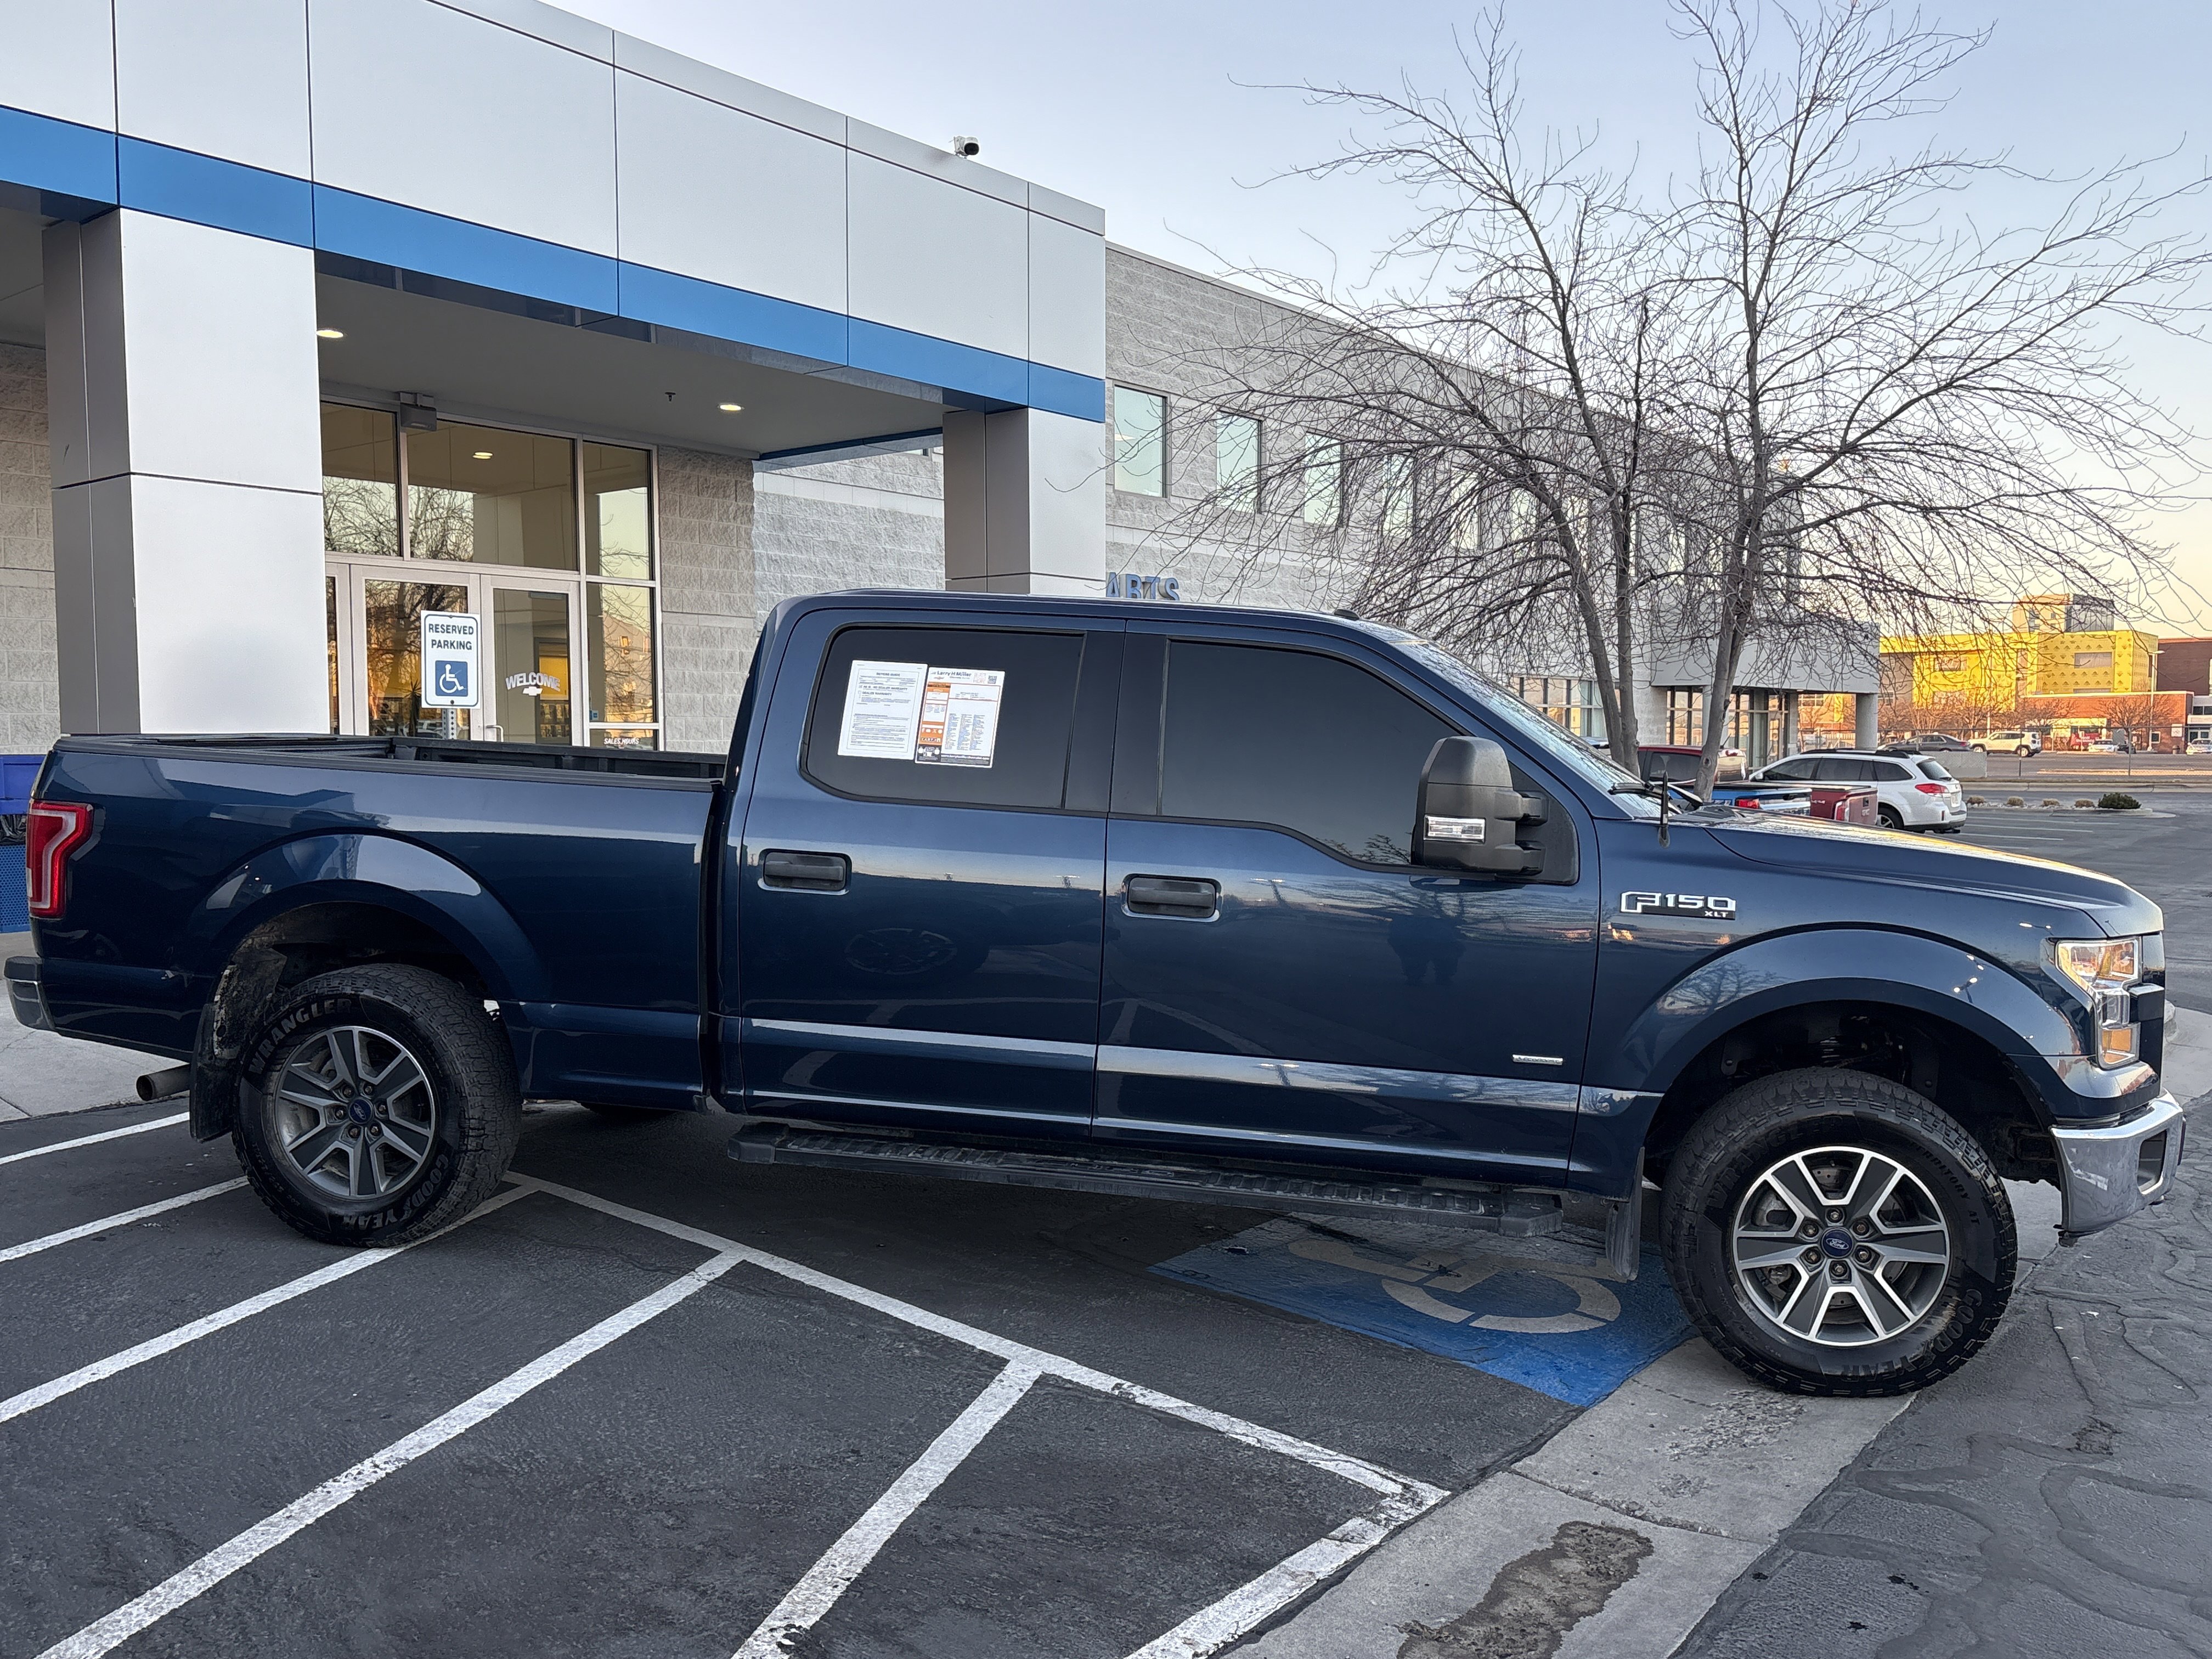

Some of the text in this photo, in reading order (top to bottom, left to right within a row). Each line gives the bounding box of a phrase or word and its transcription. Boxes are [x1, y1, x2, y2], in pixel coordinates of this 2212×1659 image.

[428, 623, 474, 635] RESERVED
[431, 639, 472, 650] PARKING
[505, 672, 561, 692] WELCOME
[249, 998, 352, 1074] WRANGLER
[342, 1154, 449, 1231] GOODYEAR
[1841, 1289, 1982, 1382] GOODYEAR
